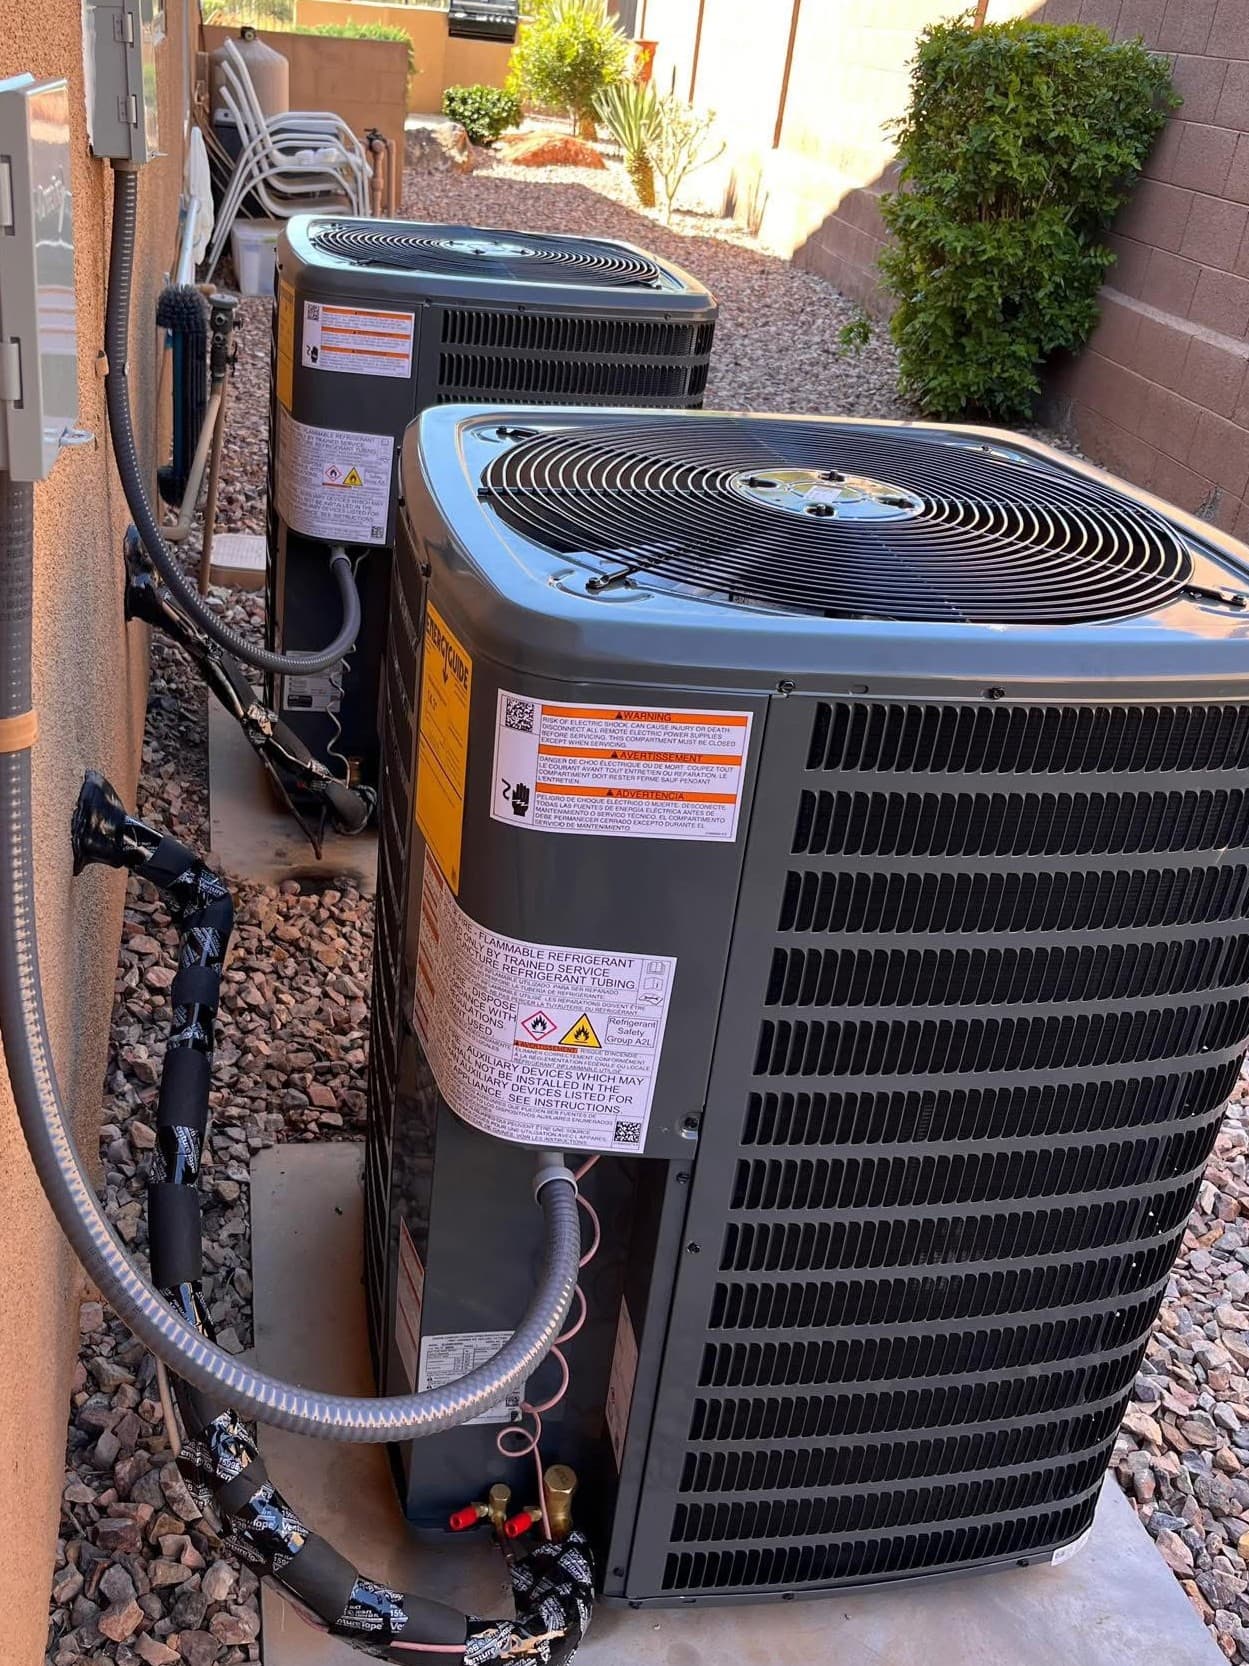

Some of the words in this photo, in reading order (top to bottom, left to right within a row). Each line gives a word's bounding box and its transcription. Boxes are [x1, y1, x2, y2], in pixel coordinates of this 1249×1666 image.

[542, 716, 558, 724] RISK
[570, 719, 603, 727] ELECTRIC
[623, 711, 672, 722] WARNING
[542, 723, 585, 732] DISCONNECT
[600, 727, 627, 735] REMOTE
[629, 729, 661, 737] ELECTRIC
[541, 730, 568, 739] BEFORE
[625, 735, 677, 744] COMPARTMENT
[541, 737, 566, 745] EXCEPT
[620, 751, 702, 763] AVERTISSEMENT
[548, 763, 580, 771] COURANT
[538, 769, 590, 778] COMPARTIMENT
[679, 777, 711, 785] PENDANT
[536, 794, 565, 802] PELIGRO
[577, 797, 605, 805] CHOQUE
[616, 790, 685, 800] ADVERTENCIA
[536, 800, 559, 808] TODAS
[573, 803, 604, 811] FUENTES
[554, 814, 599, 823] PERMANECER
[600, 817, 632, 825] CERRADO
[633, 818, 664, 827] EXCEPTO
[668, 814, 726, 823] COMPARTIMENTO
[463, 932, 485, 953] ONLY
[486, 947, 501, 959] BY
[503, 953, 555, 972] TRAINED
[557, 963, 610, 977] SERVICE
[479, 931, 545, 960] FLAMMABLE
[548, 951, 634, 968] REFRIGERANT
[502, 963, 587, 985] REFRIGERANT
[591, 977, 635, 989] TUBING
[472, 986, 516, 1012] DISPOSE
[488, 1004, 517, 1022] WITH
[609, 1017, 656, 1029] Refrigerant
[617, 1028, 645, 1037] Safety
[607, 1035, 634, 1046] Group
[635, 1038, 651, 1046] A2L
[467, 1045, 519, 1073] AUXILIARY
[522, 1067, 573, 1080] DEVICES
[576, 1072, 616, 1084] WHICH
[617, 1076, 644, 1086] MAY
[460, 1060, 508, 1089] AUXILIARY
[511, 1083, 562, 1098] DEVICES
[565, 1090, 605, 1102] LISTED
[609, 1095, 633, 1104] FOR
[474, 1060, 496, 1075] NOT
[498, 1070, 513, 1081] BE
[516, 1074, 579, 1090] INSTALLED
[582, 1083, 594, 1091] IN
[597, 1084, 620, 1093] THE
[508, 1093, 532, 1106] SEE
[534, 1097, 623, 1114] INSTRUCTIONS.
